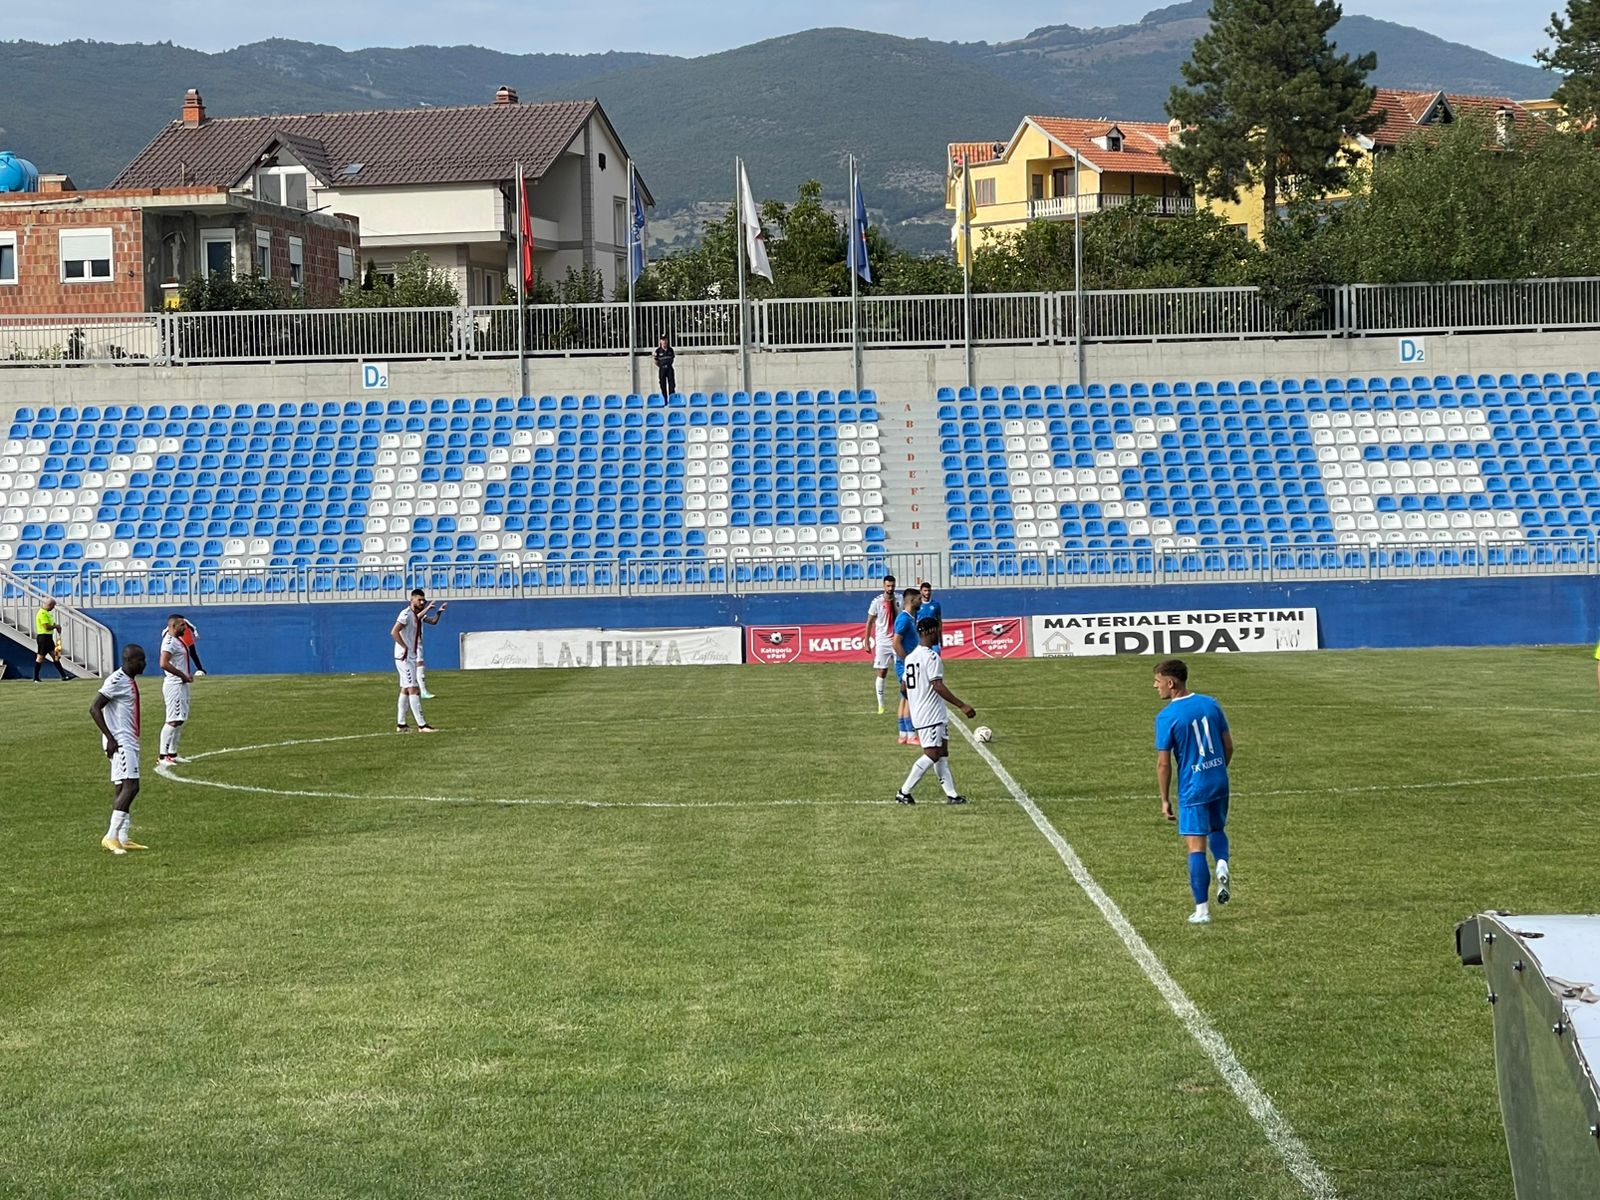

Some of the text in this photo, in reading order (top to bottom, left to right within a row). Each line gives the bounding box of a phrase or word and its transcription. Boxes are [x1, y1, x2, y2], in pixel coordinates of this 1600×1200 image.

[1401, 339, 1424, 362] D2
[364, 365, 387, 387] D2
[904, 404, 911, 412] A
[907, 453, 915, 461] D
[909, 470, 917, 479] E
[911, 487, 919, 496] F
[911, 504, 919, 512] G
[912, 522, 920, 530] H
[1044, 610, 1304, 629] MATERIALE NDERTIMI
[537, 640, 682, 667] LAJTHIZA
[1191, 715, 1215, 757] 11
